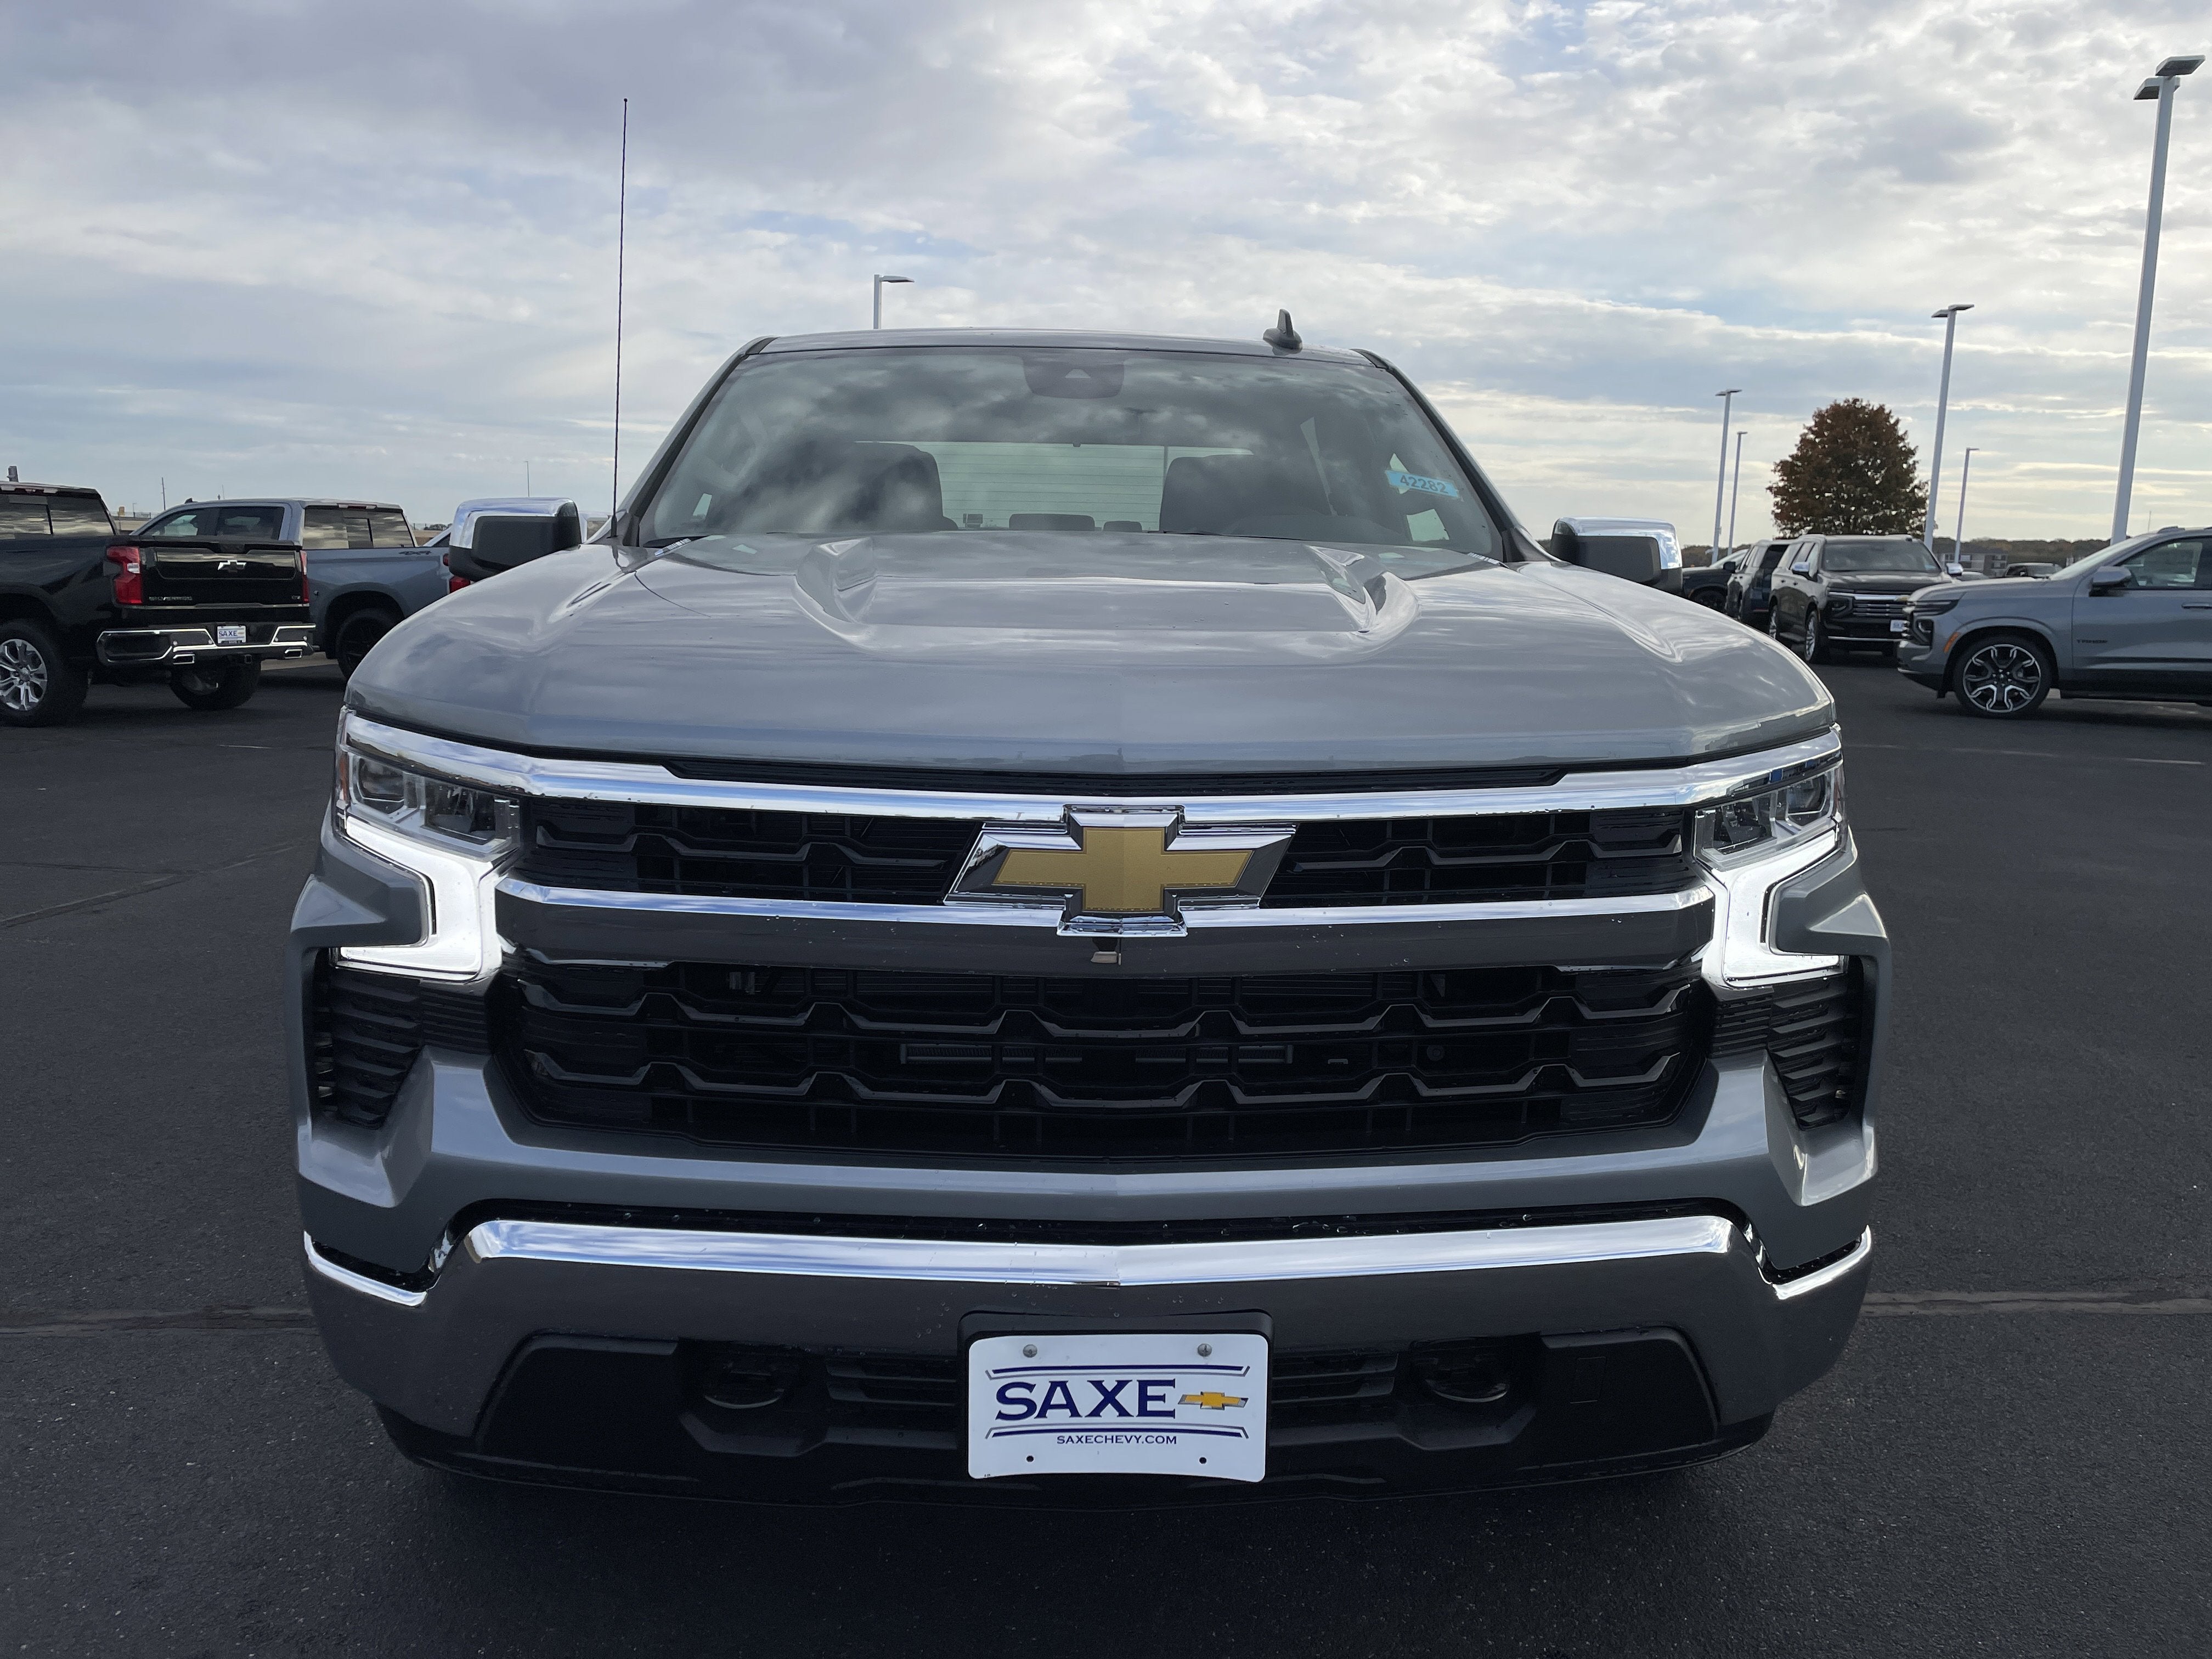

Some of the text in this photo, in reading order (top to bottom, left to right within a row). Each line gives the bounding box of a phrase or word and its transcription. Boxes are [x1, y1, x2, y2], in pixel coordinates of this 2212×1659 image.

[1400, 474, 1449, 494] 42282
[995, 1378, 1176, 1421] SAXE
[1056, 1435, 1177, 1445] SAXECHEVY.COM
